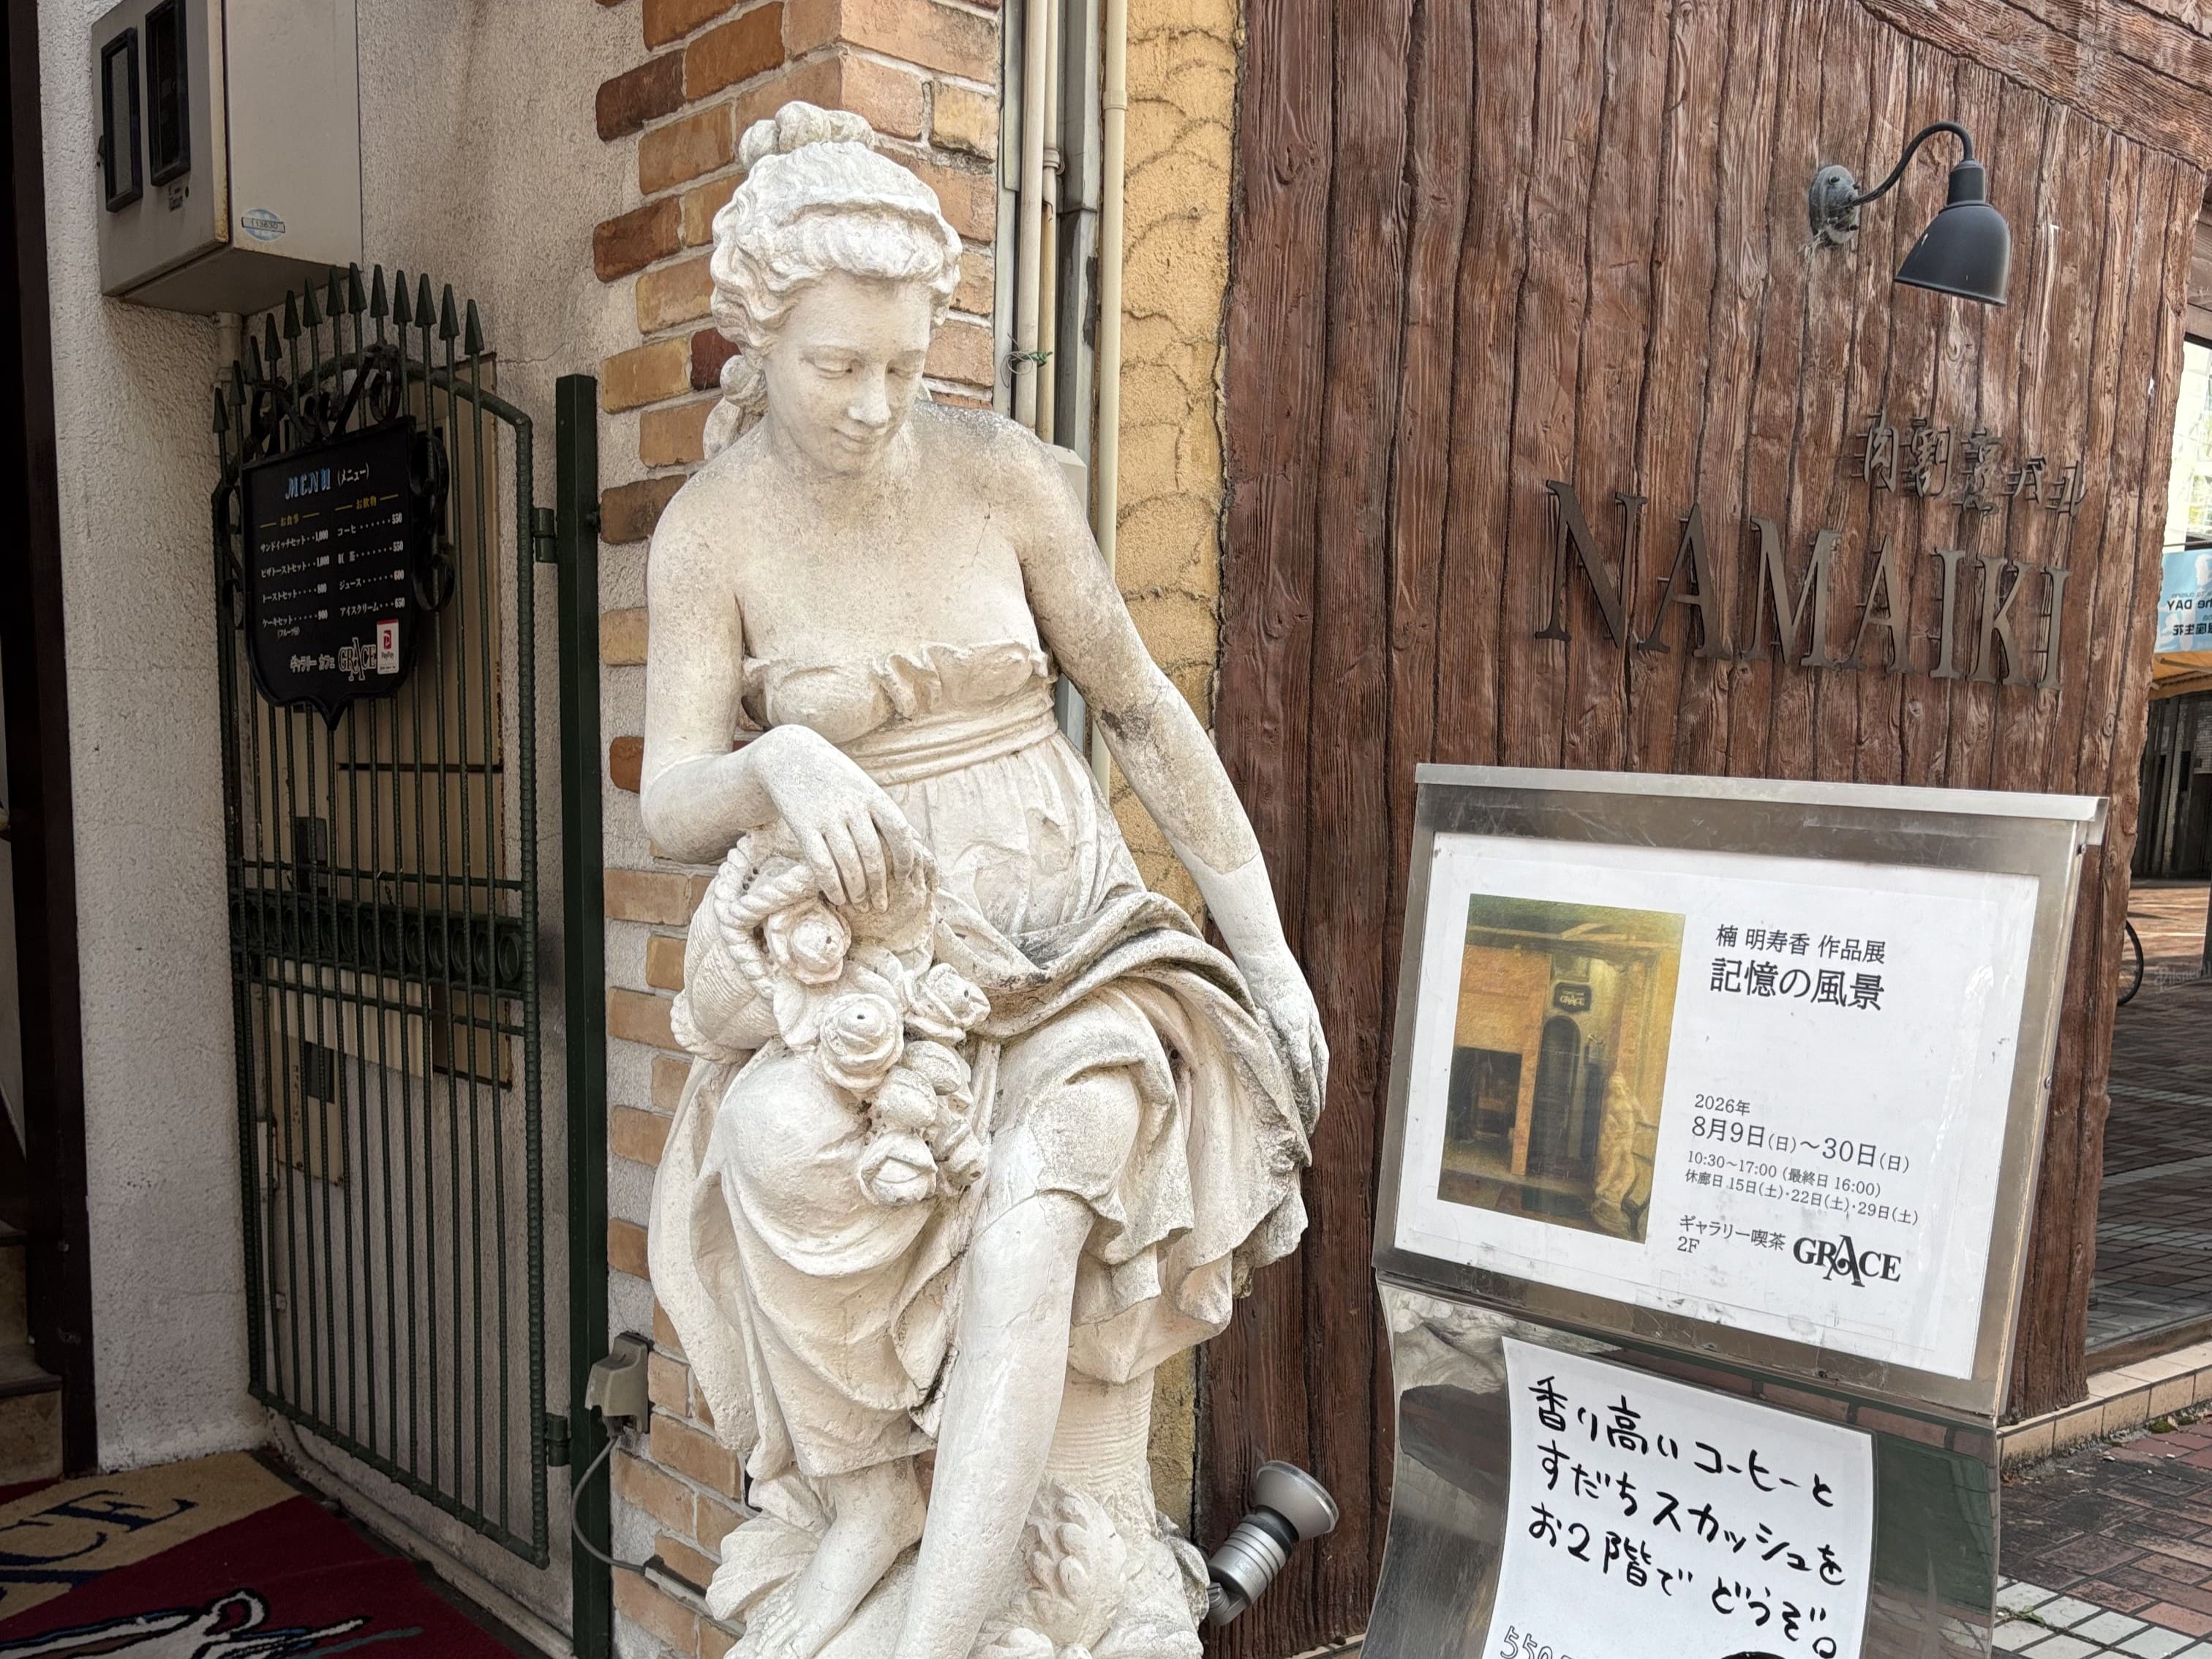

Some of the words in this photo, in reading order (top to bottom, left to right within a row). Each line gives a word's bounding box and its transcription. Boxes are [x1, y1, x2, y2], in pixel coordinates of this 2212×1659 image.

[285, 467, 331, 500] MENU
[1535, 478, 2072, 691] NAMAIKI
[338, 636, 377, 682] GRACE
[1715, 923, 1738, 948] 楠
[1745, 928, 1810, 956] 明寿香
[1817, 933, 1886, 965] 作品展
[1709, 957, 1885, 1012] 記憶の風景
[1694, 1094, 1751, 1117] 2026年
[1685, 1169, 1723, 1189] 休廊日
[1835, 1176, 1881, 1198] 16:00)
[1677, 1235, 1700, 1254] 2F
[1679, 1214, 1786, 1252] ギャラリー喫茶
[1792, 1234, 1902, 1287] GRACE
